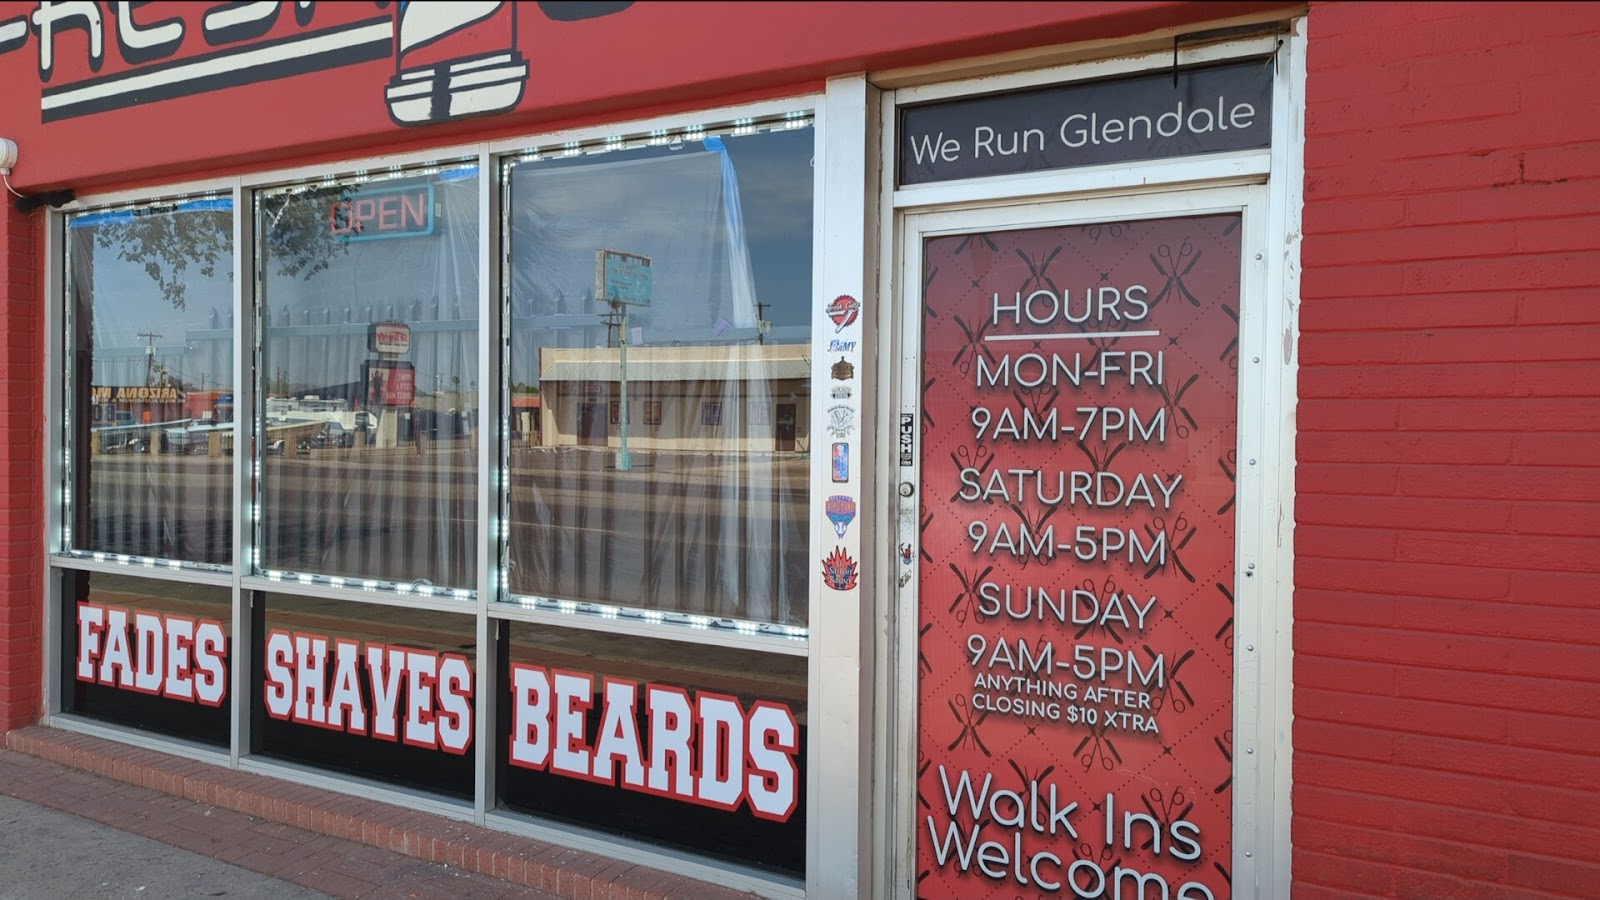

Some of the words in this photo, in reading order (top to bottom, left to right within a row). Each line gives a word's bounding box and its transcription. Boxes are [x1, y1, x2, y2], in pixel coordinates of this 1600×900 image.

[911, 132, 961, 165] We
[974, 126, 1044, 159] Run
[1060, 96, 1255, 148] Glendale
[330, 193, 424, 234] OPEN
[993, 285, 1149, 324] HOURS
[976, 350, 1163, 387] MON-FRI
[901, 416, 912, 454] PUSH
[971, 407, 1165, 442] 9AM-7PM
[959, 467, 1182, 508] SATURDAY
[968, 520, 1166, 565] 9AM-5PM
[978, 582, 1156, 629] SUNDAY
[77, 601, 227, 707] FADES
[967, 634, 1164, 688] 9AM-5PM
[264, 628, 473, 755] SHAVES
[974, 673, 1077, 700] ANYTHING
[1084, 686, 1150, 710] AFTER
[972, 694, 1060, 720] CLOSING
[1066, 705, 1098, 726] $10
[1104, 711, 1159, 734] XTRA
[509, 662, 799, 824] BEARDS
[939, 765, 1078, 839] Walk
[1106, 793, 1201, 860] Ins
